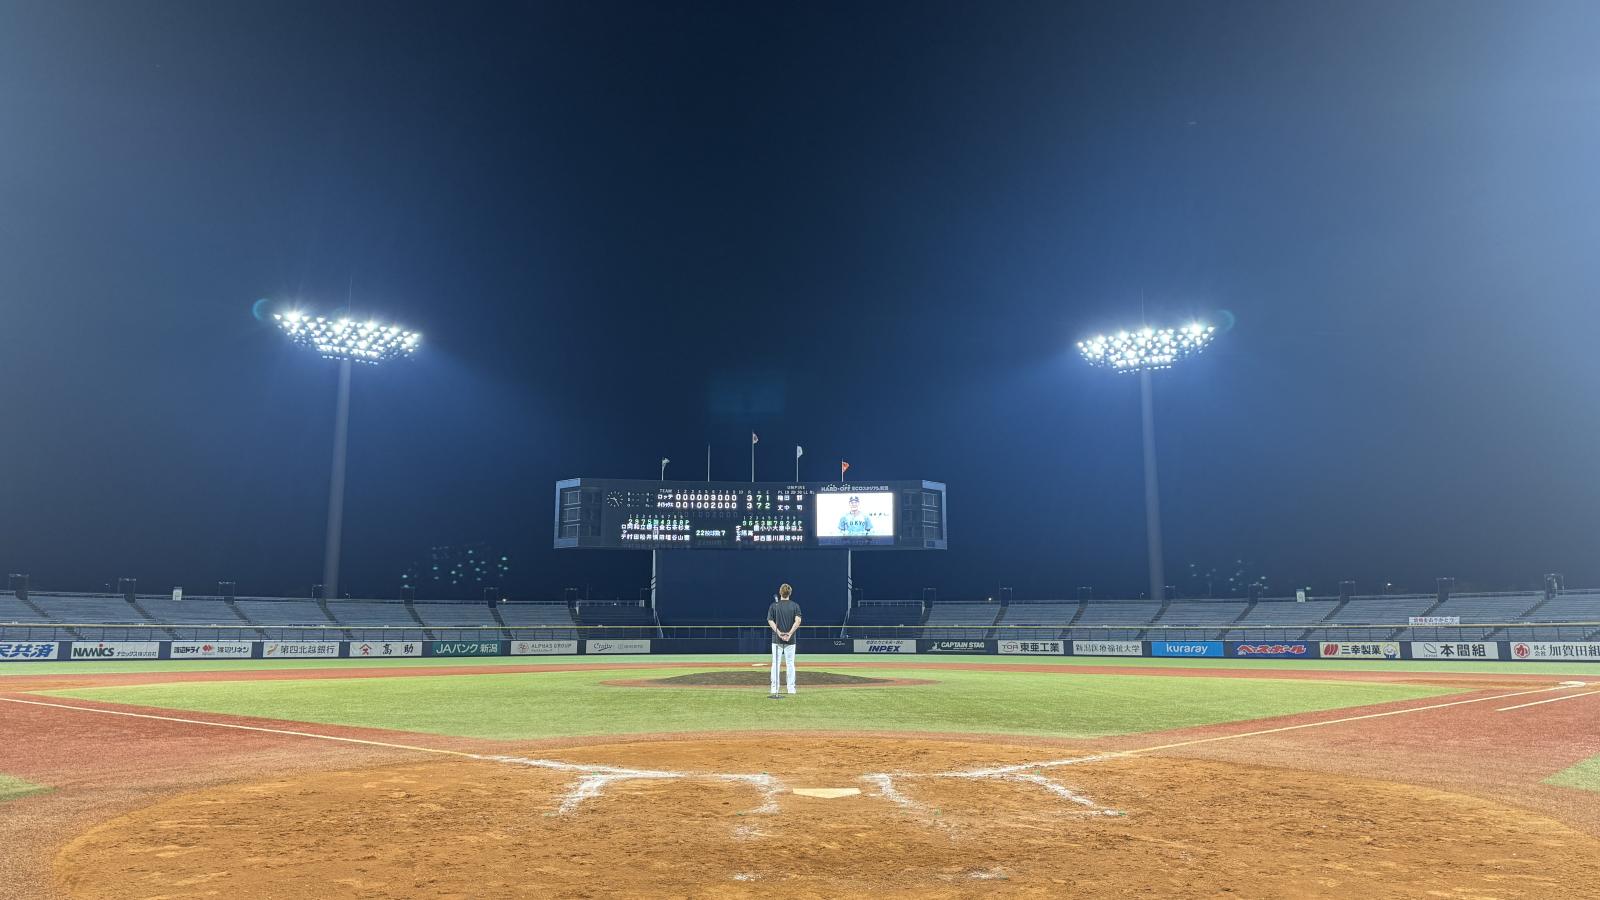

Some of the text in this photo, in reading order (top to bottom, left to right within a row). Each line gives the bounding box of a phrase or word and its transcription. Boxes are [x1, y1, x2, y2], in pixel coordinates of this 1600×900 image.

[281, 645, 335, 654] 第四北越銀行
[436, 644, 498, 653] JAバンク 新潟
[1020, 642, 1059, 652] 東亜工業
[1166, 644, 1208, 654] kuraray
[1341, 645, 1381, 655] 三幸製菓
[1440, 644, 1486, 656] 本間組
[1549, 645, 1600, 656] 加賀田組
